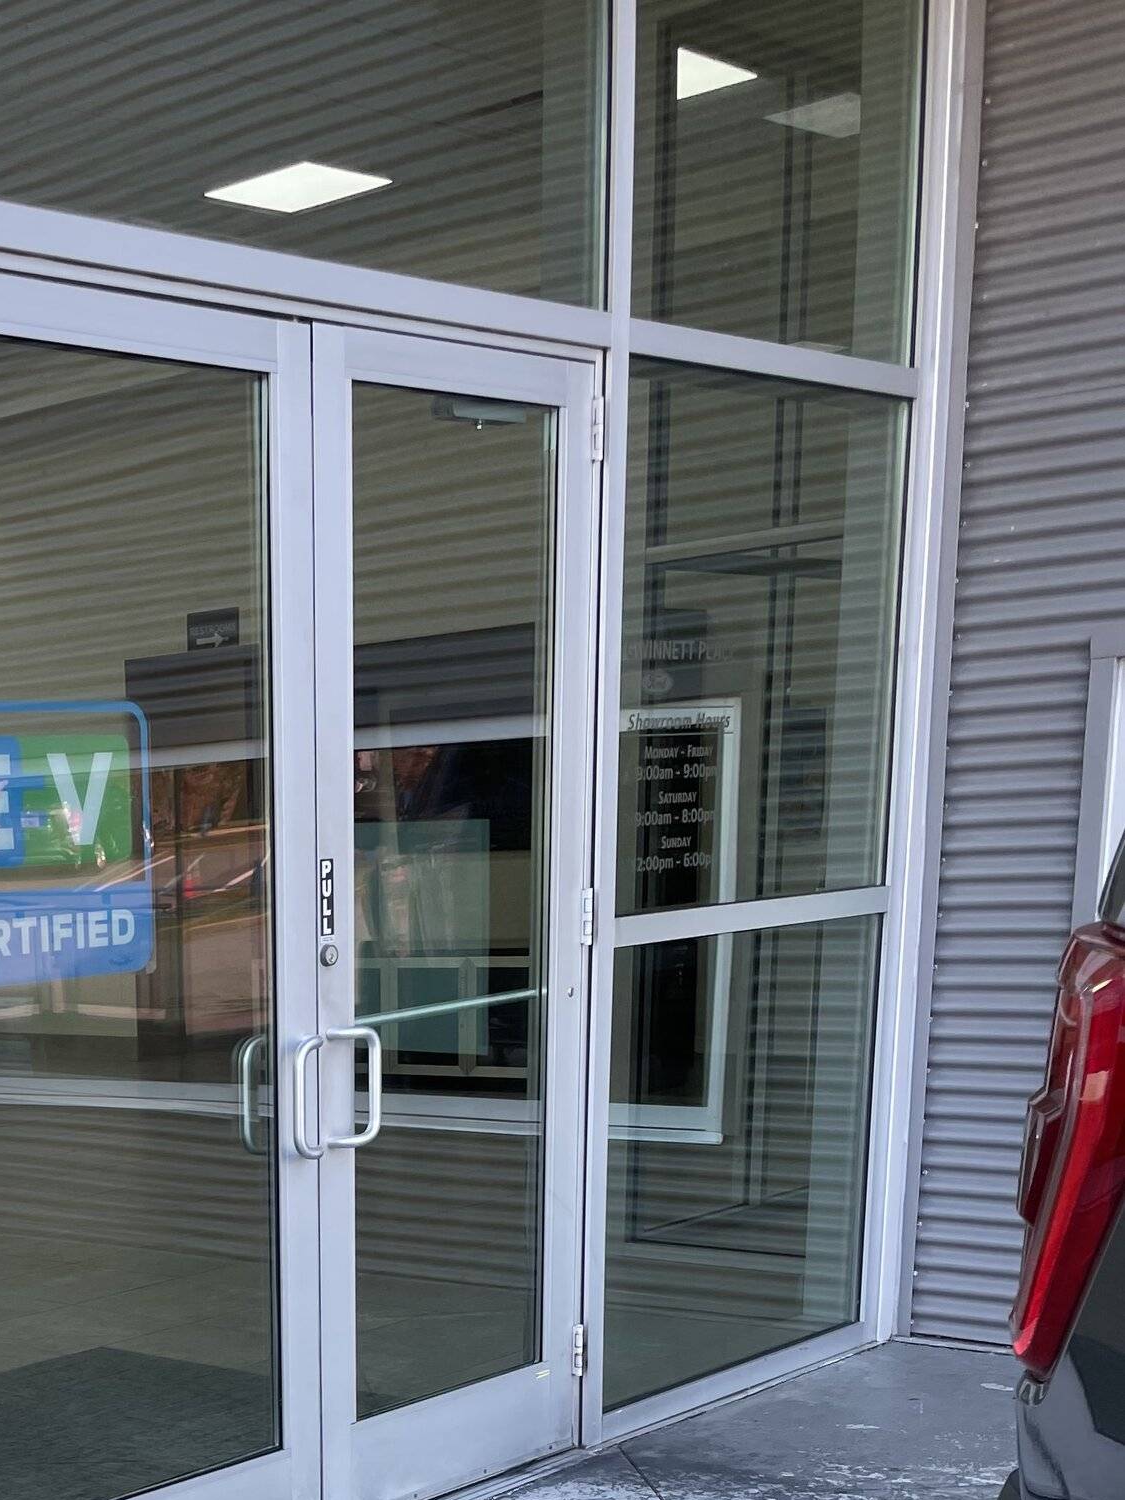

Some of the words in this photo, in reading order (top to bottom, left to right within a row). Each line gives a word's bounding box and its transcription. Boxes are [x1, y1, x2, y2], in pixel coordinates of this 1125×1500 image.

[628, 712, 692, 730] Showroom
[696, 711, 731, 729] Hours
[636, 764, 674, 782] 9:00am
[635, 810, 672, 826] 9:00am
[633, 855, 674, 874] 2:00pm
[683, 851, 713, 869] 6:00p
[321, 860, 332, 935] PULL
